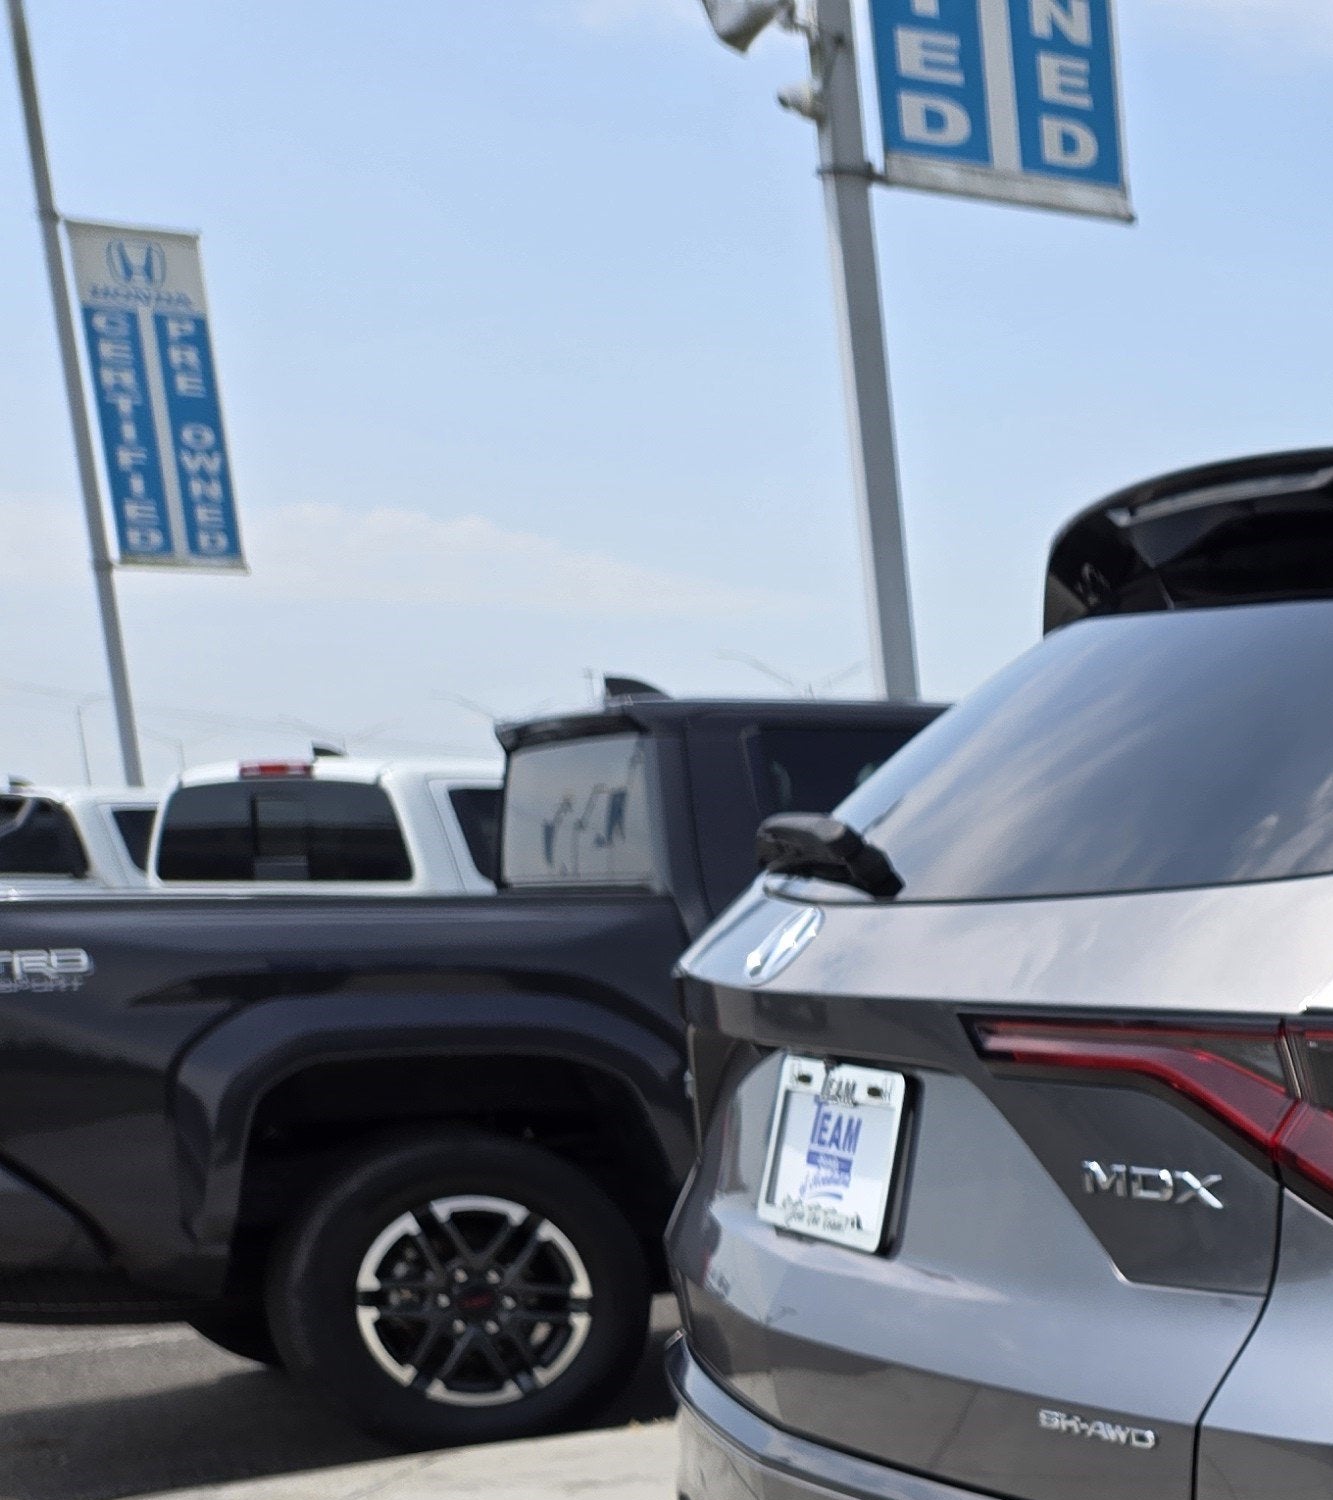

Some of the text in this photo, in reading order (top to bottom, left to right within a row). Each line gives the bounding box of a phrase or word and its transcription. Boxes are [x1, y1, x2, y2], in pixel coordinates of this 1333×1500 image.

[92, 310, 165, 552] CERTIFIED
[166, 316, 229, 552] PRE OWNED
[1081, 1159, 1225, 1211] MDX
[1038, 1408, 1157, 1450] SH-AWD
